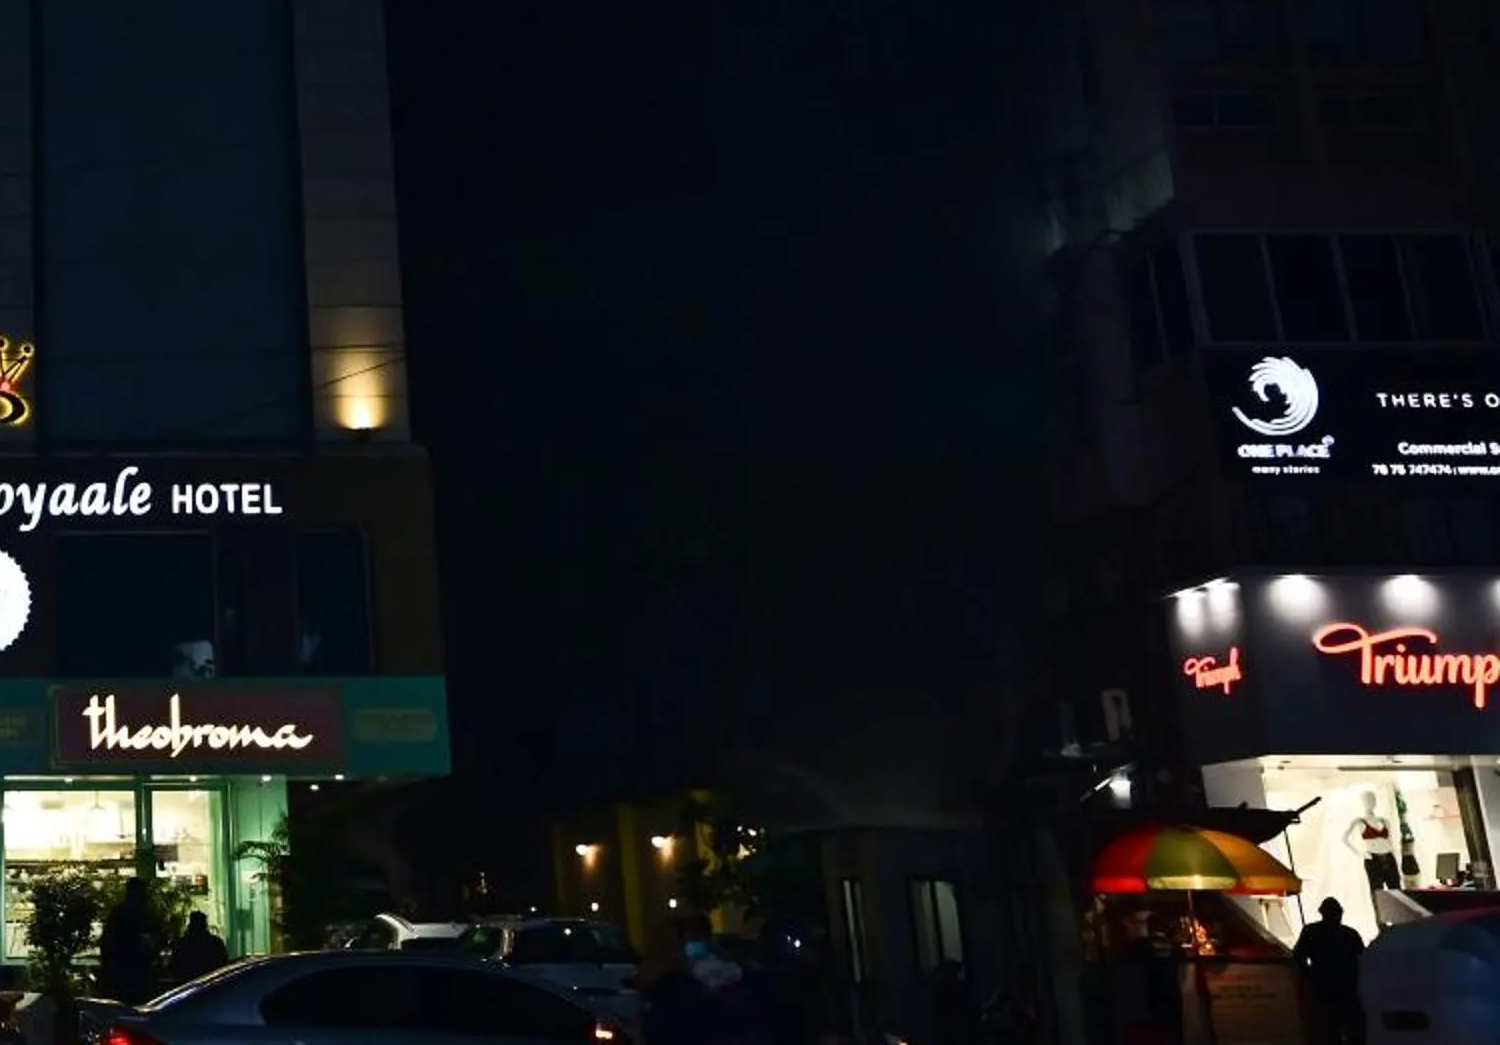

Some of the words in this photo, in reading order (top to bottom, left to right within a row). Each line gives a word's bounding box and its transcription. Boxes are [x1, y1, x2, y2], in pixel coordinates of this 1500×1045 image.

[1376, 392, 1474, 408] THERE'S
[1397, 441, 1488, 456] Commercial
[170, 482, 283, 515] HOTEL
[1312, 623, 1500, 708] Triump
[82, 694, 313, 758] theobroma
